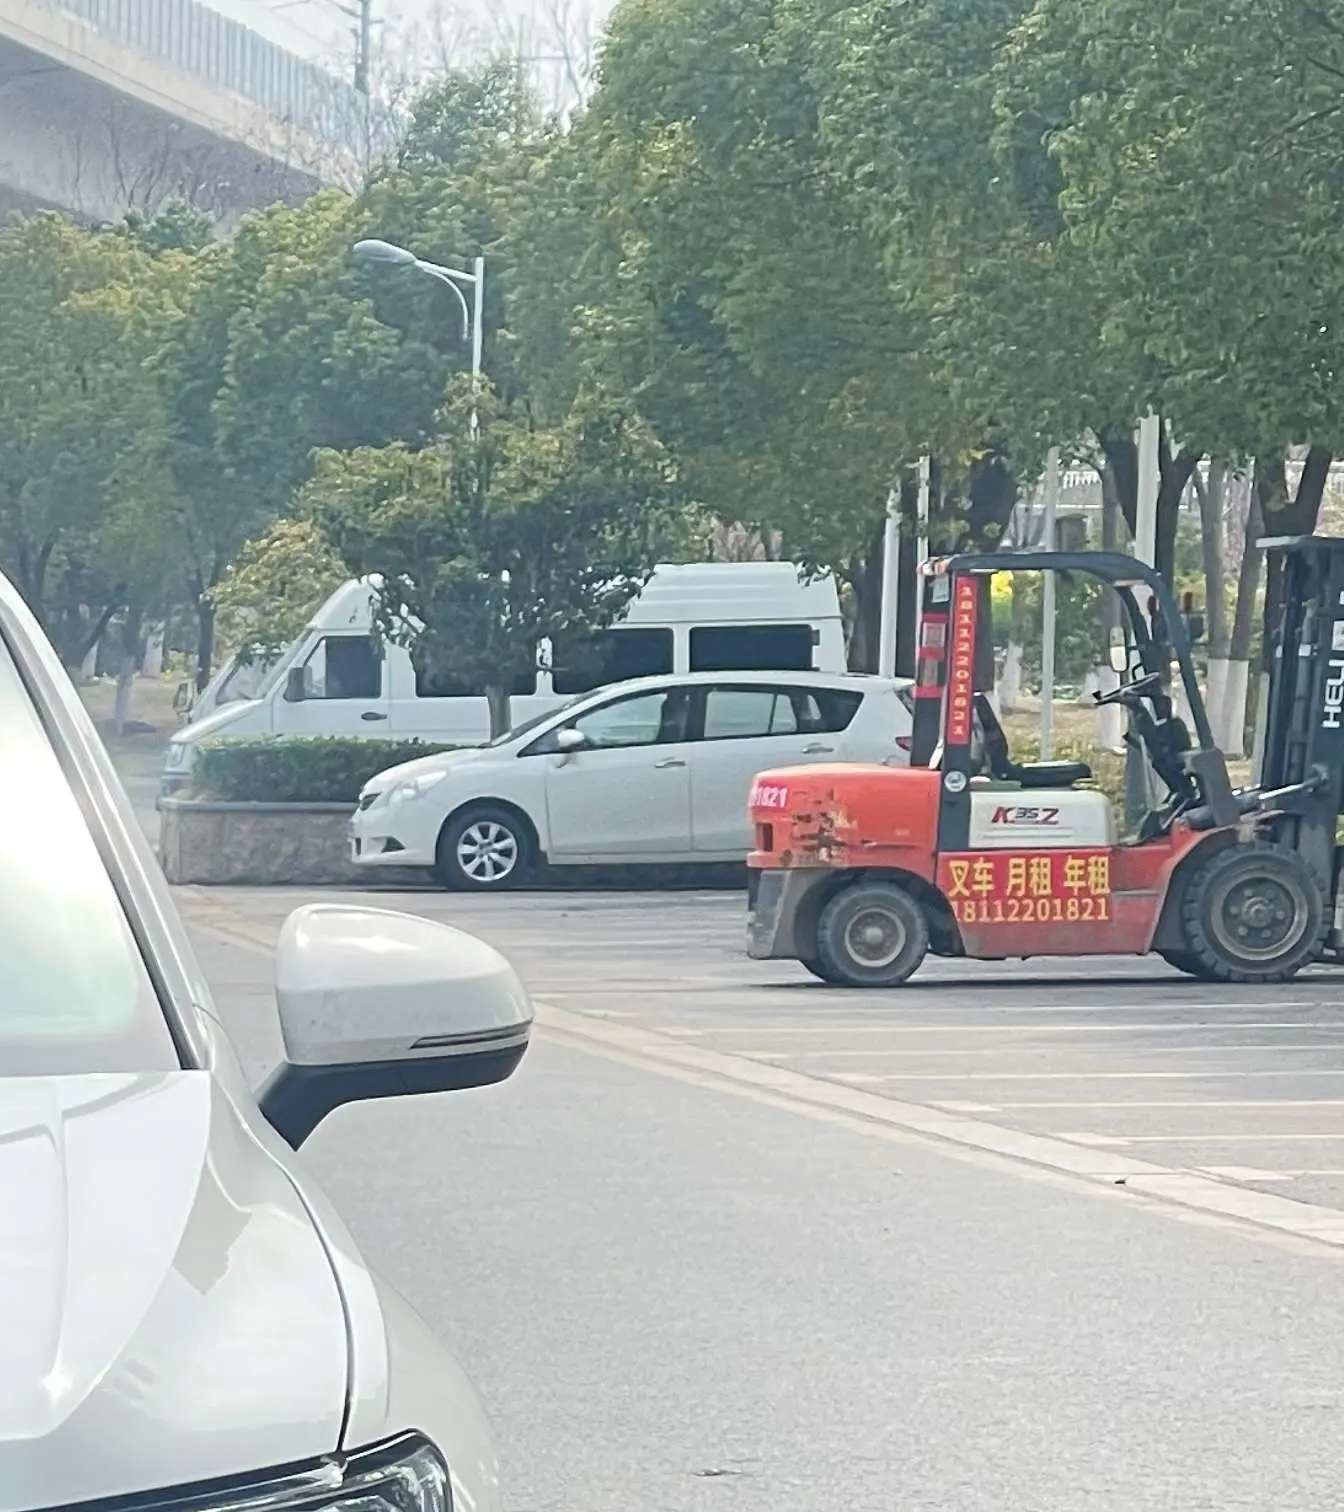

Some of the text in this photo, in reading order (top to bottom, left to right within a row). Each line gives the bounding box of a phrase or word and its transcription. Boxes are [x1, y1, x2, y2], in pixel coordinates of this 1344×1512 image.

[948, 855, 1111, 897] 叉车 月租 年租
